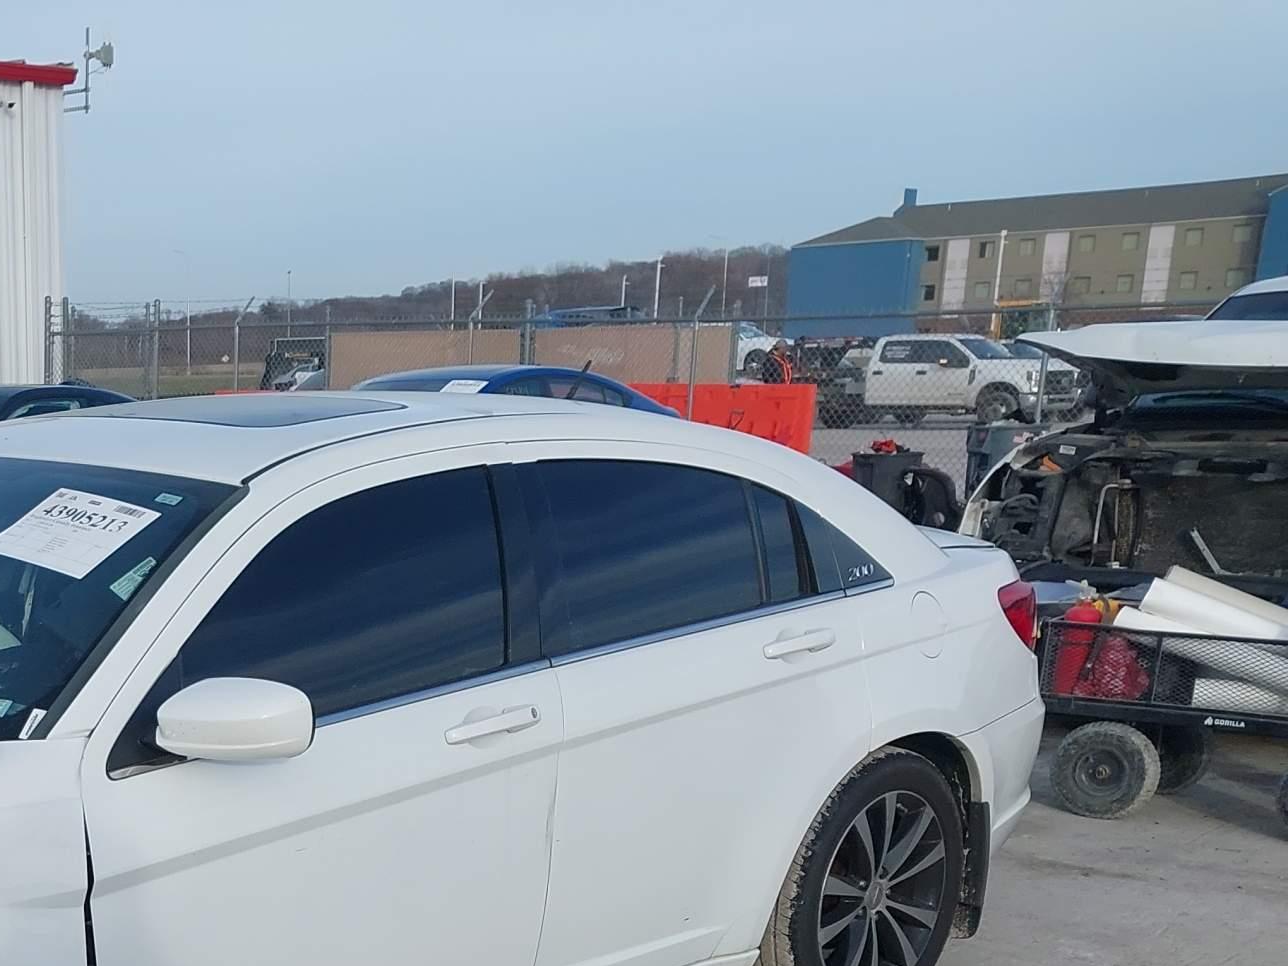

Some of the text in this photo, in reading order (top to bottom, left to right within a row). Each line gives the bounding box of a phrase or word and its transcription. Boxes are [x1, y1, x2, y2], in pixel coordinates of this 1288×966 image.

[42, 503, 129, 534] 43905213
[848, 563, 874, 581] 200
[1214, 718, 1246, 727] GORILLA
